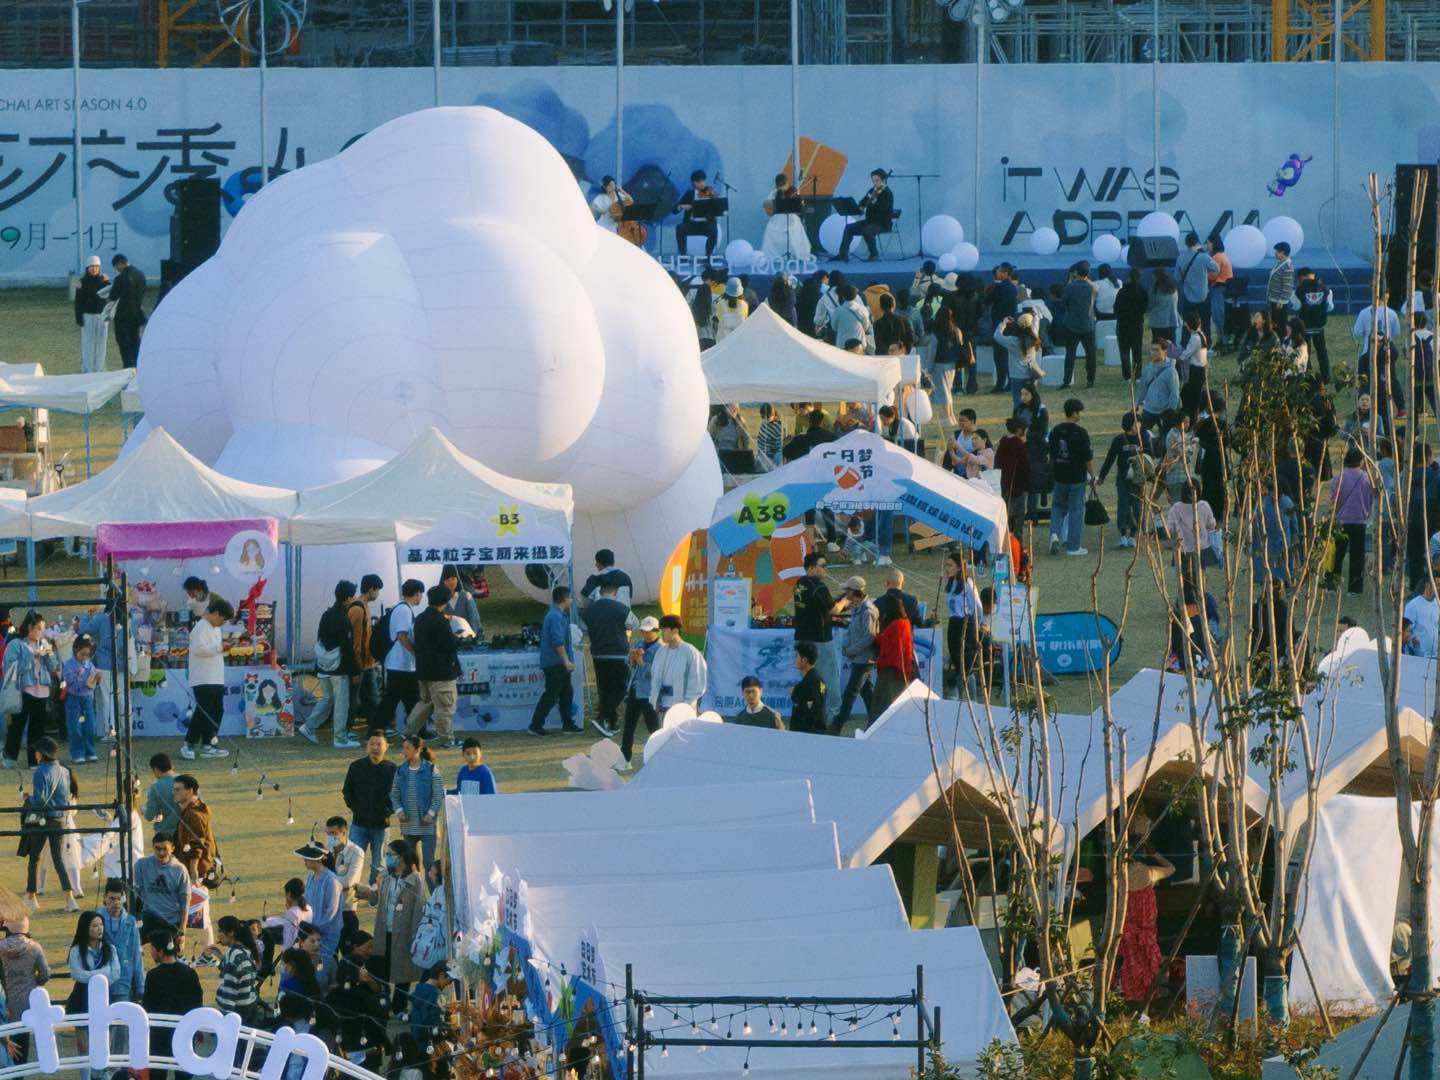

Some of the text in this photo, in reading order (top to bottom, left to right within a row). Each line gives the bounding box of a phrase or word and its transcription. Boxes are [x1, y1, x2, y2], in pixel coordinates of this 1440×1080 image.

[34, 98, 60, 112] ART
[125, 97, 148, 111] 4.0
[1054, 166, 1181, 202] WAS
[1000, 210, 1037, 246] A
[499, 513, 520, 526] B3
[737, 505, 787, 524] A38
